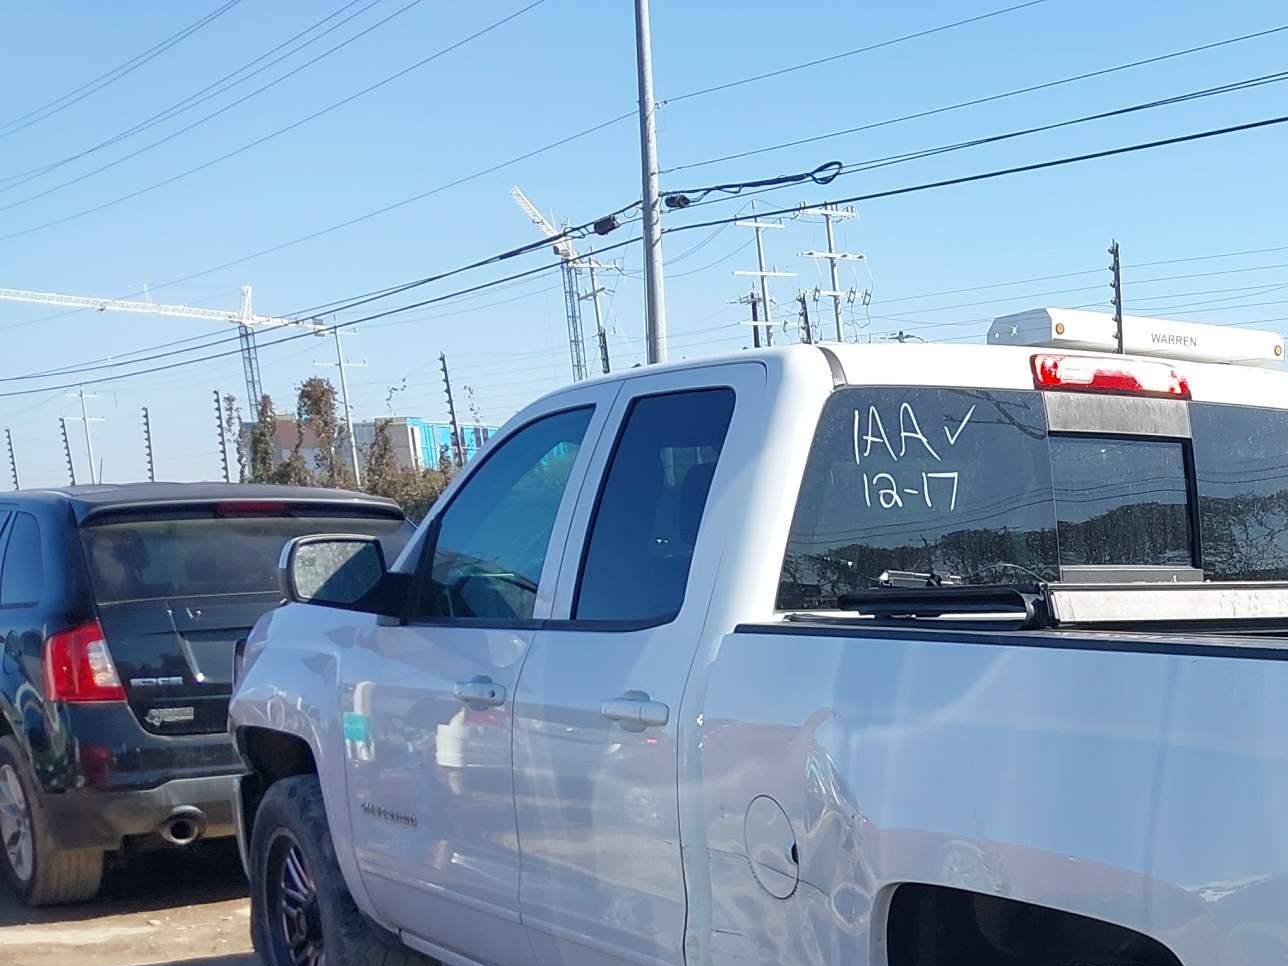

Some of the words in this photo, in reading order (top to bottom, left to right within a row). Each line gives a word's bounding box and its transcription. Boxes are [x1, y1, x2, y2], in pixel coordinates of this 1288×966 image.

[1151, 333, 1197, 347] WARREN
[854, 402, 942, 465] IAA
[863, 471, 959, 512] 12-17
